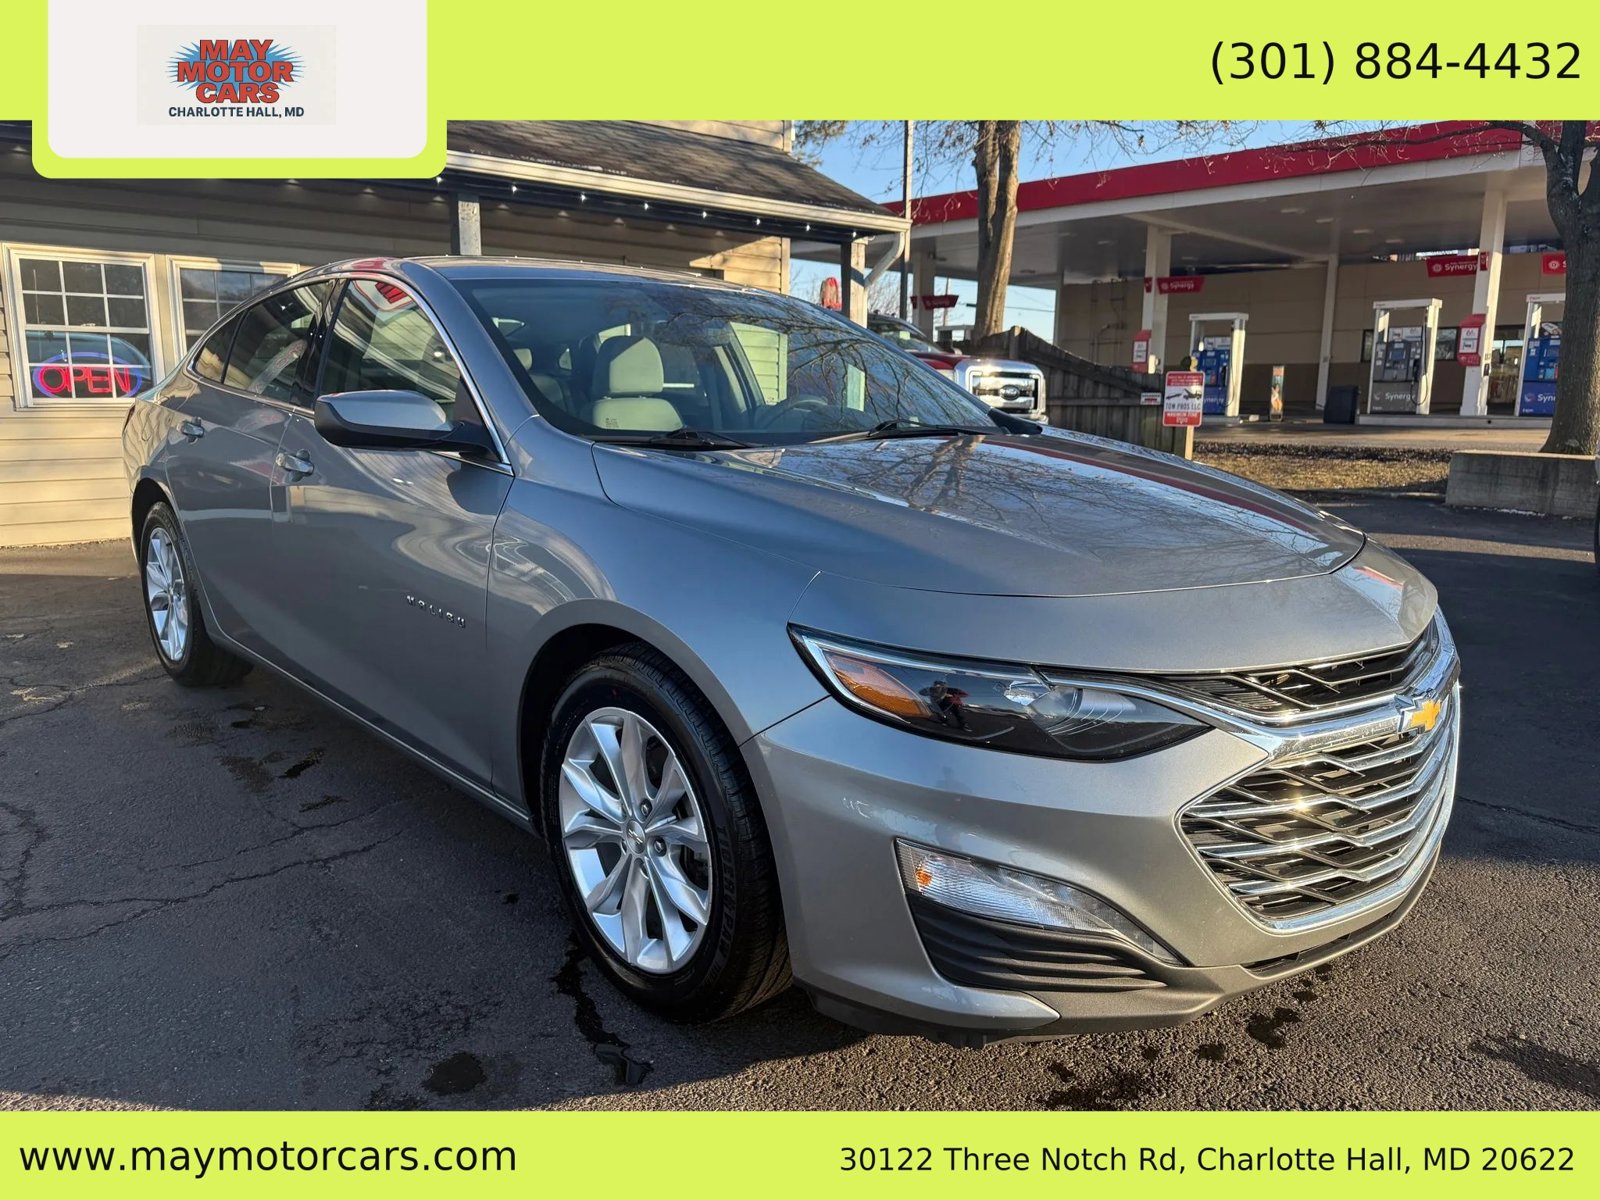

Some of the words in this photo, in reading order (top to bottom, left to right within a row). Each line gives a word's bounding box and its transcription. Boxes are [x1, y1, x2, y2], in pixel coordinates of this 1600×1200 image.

[1445, 263, 1478, 272] Synergy
[39, 364, 131, 393] OPEN
[406, 595, 466, 629] MALIBU
